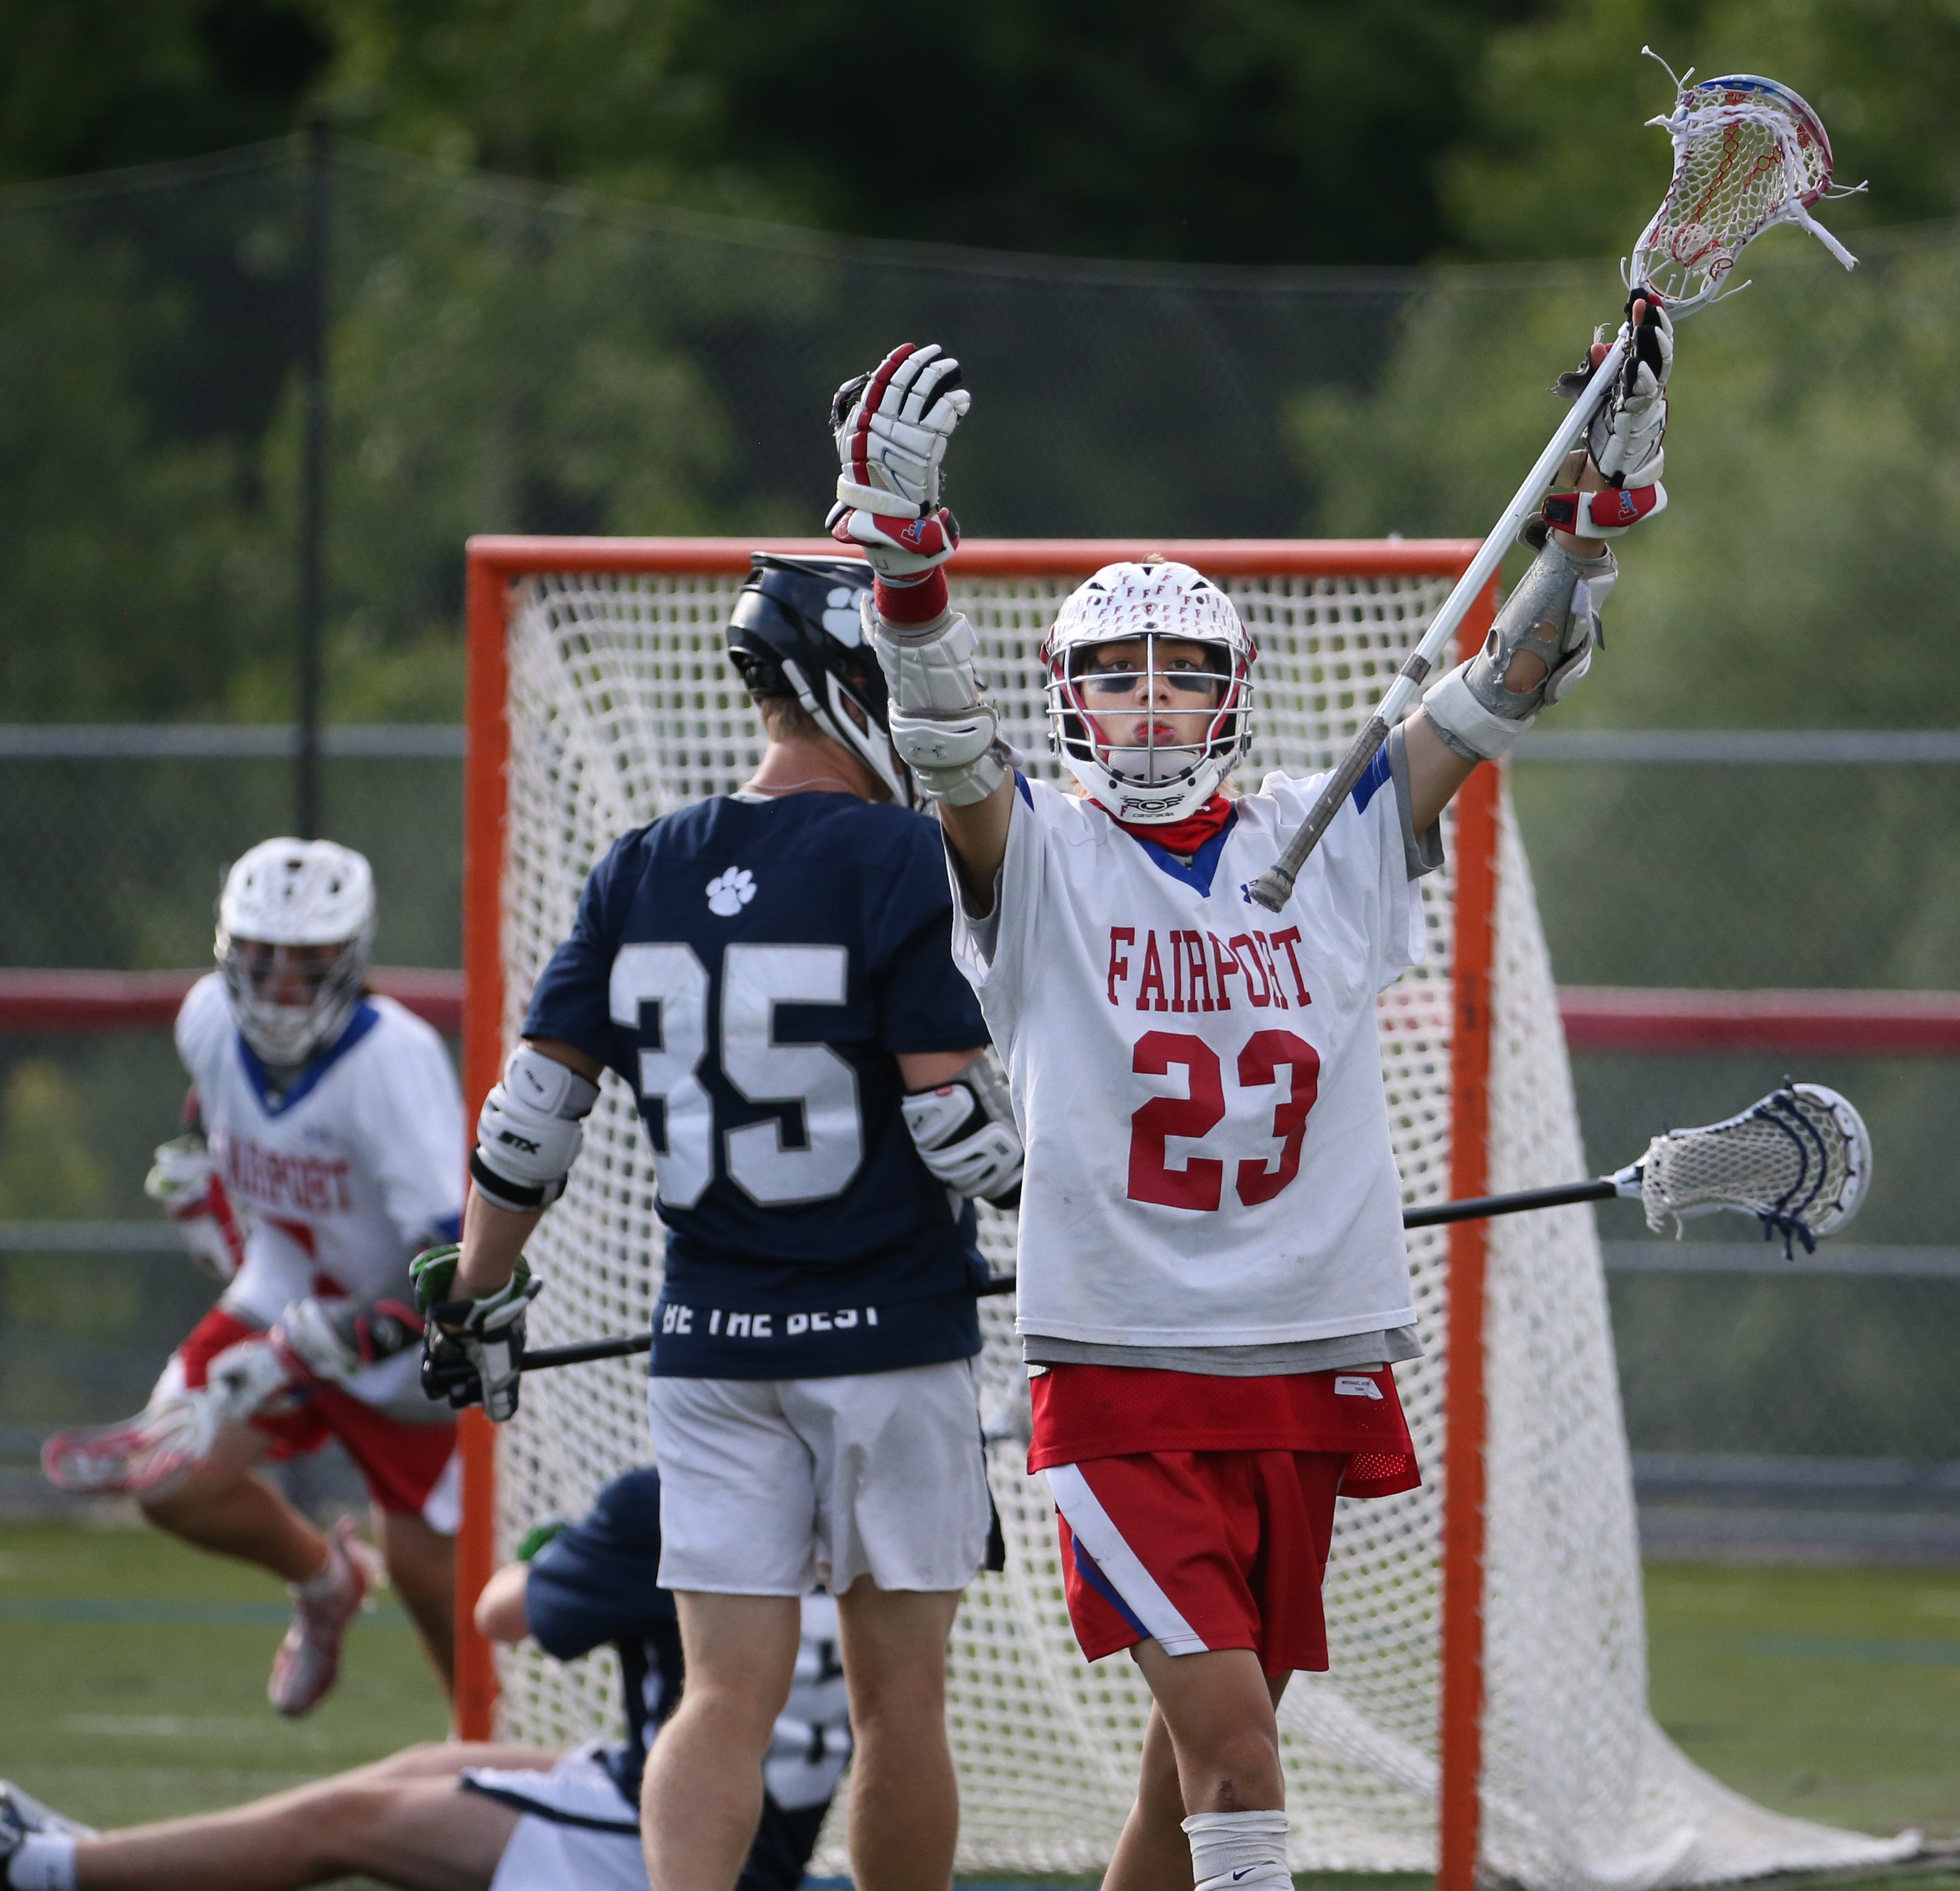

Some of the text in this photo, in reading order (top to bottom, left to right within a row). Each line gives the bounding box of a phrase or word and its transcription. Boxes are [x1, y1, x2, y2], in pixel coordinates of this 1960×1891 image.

[1120, 805, 1128, 816] F
[1107, 925, 1312, 1012] FAIRPORT
[609, 941, 864, 1210] 35
[1127, 1029, 1320, 1211] 23
